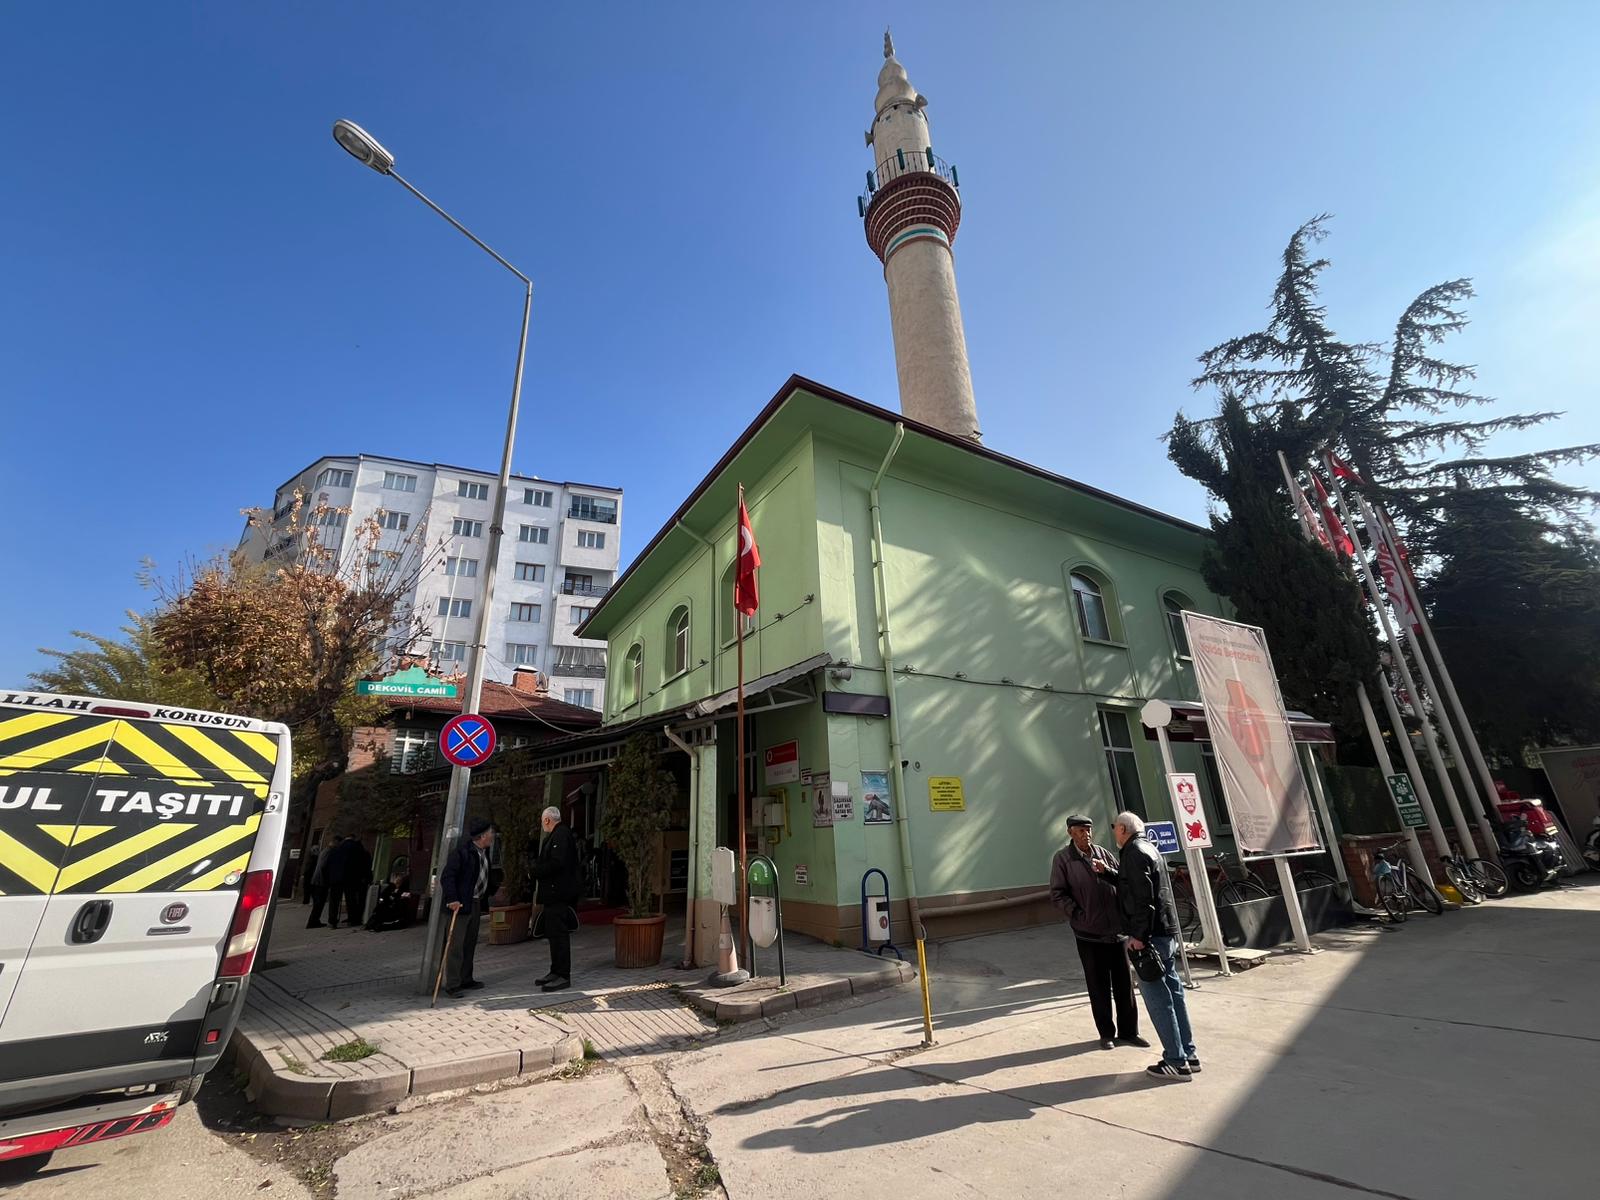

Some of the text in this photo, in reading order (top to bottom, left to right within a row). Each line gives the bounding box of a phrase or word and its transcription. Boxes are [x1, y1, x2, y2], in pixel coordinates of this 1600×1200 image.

[368, 684, 446, 695] DEKOVİL CAMİİ
[153, 709, 252, 728] KORUSUN
[96, 790, 243, 819] TAŞITI
[168, 907, 185, 918] FIAT
